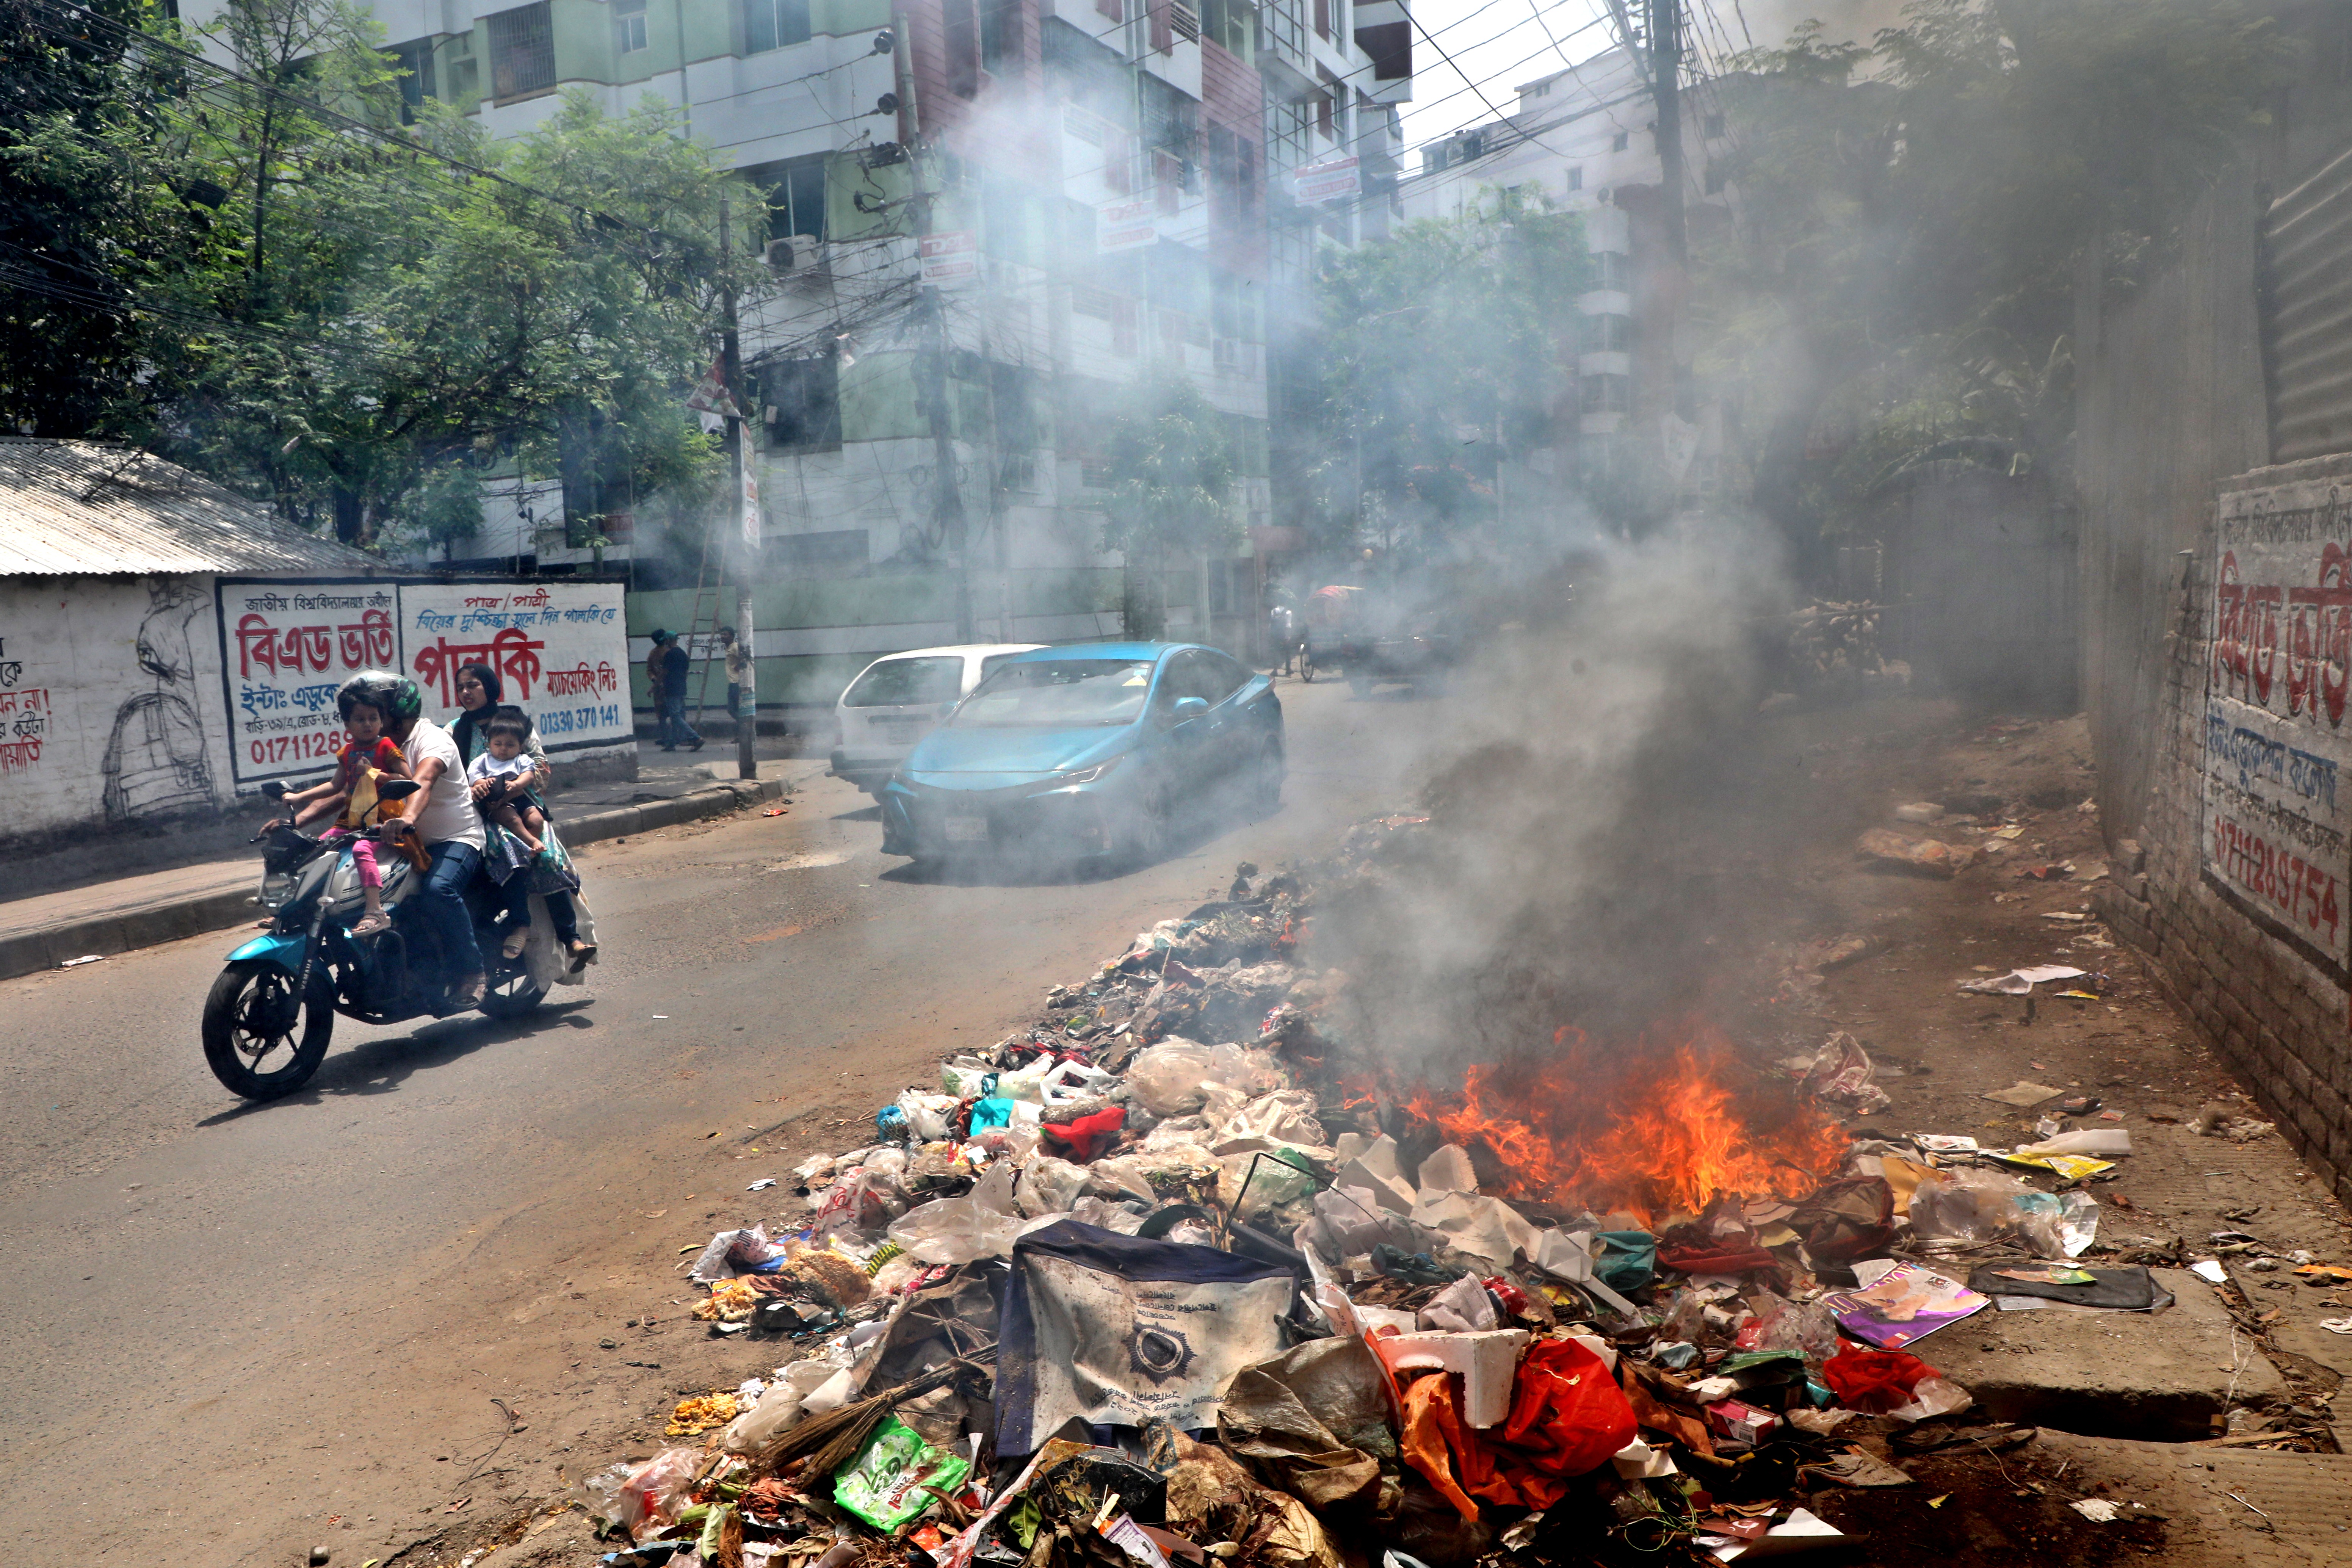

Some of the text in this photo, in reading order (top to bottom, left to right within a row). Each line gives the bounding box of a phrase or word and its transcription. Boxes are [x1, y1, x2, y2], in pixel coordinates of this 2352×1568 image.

[245, 592, 289, 611] জাতীয়
[367, 591, 392, 607] অধীনে
[417, 609, 455, 633] বিয়ের
[539, 606, 559, 627] দিন
[235, 609, 394, 681] বিএড ভর্তি
[414, 628, 544, 708] পালকি
[540, 704, 619, 735] 01330 370 141
